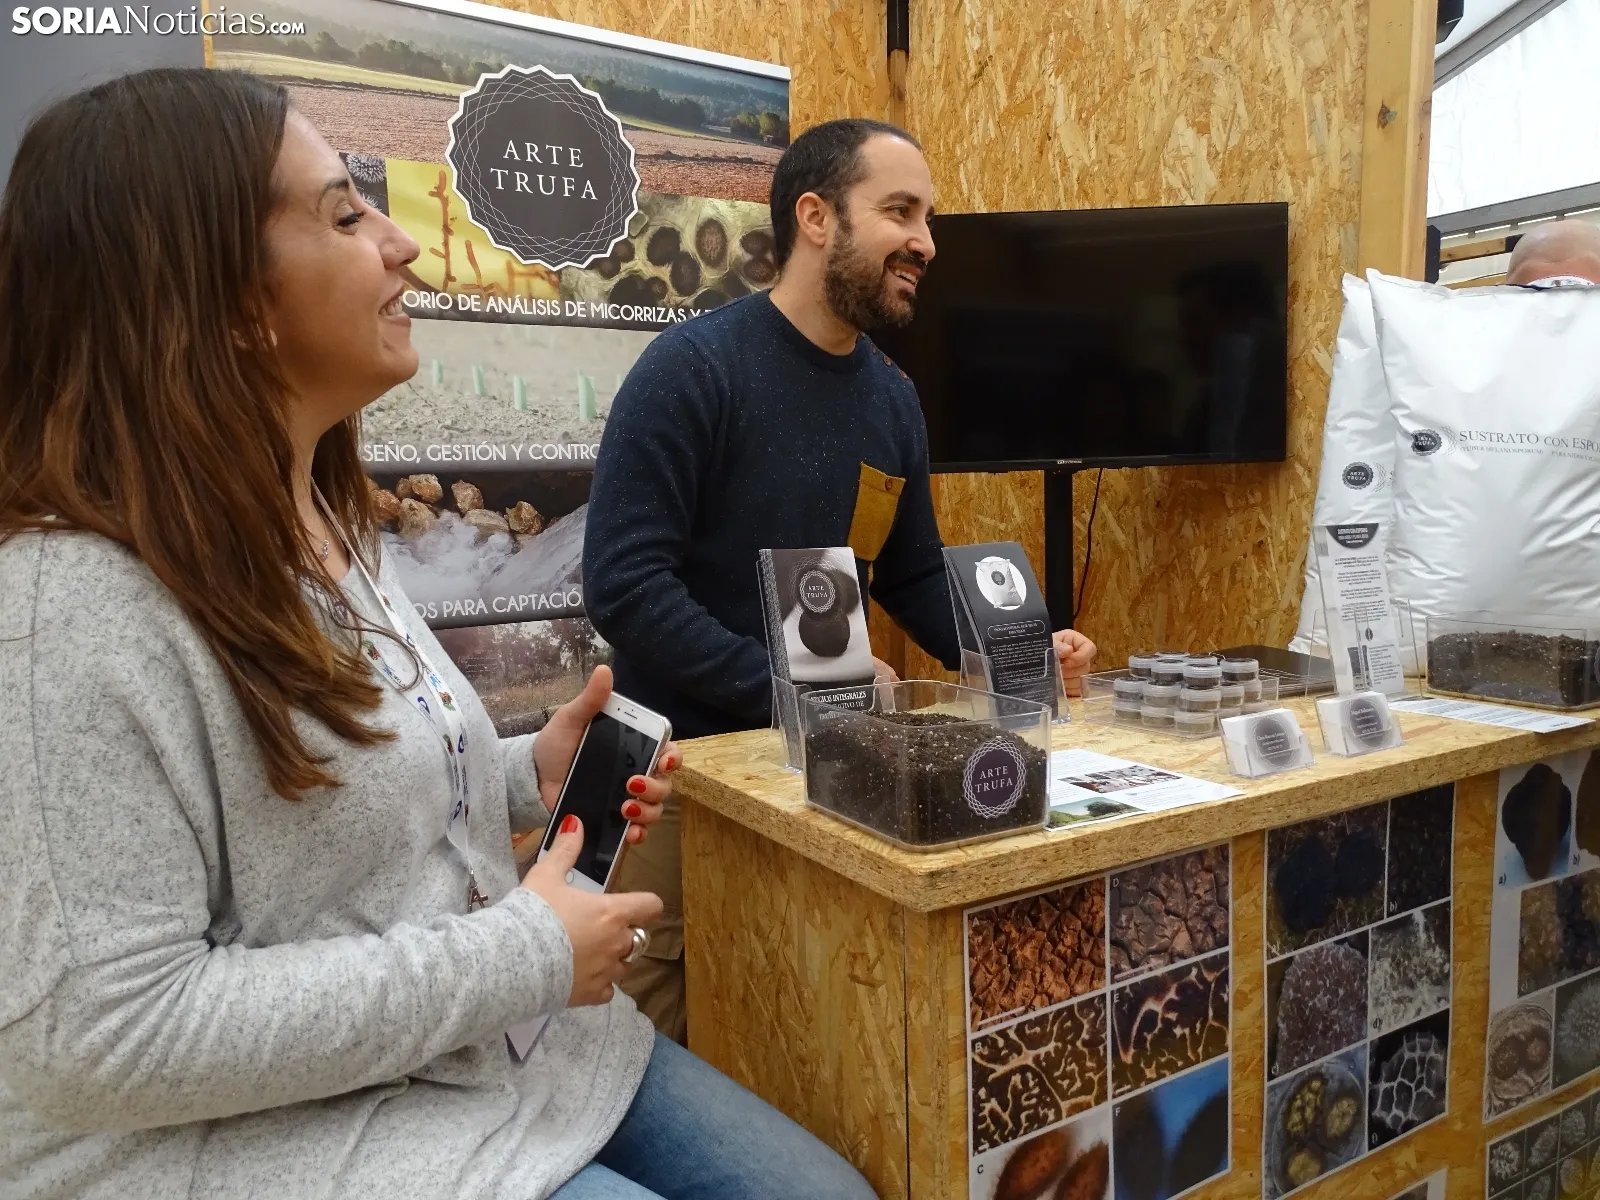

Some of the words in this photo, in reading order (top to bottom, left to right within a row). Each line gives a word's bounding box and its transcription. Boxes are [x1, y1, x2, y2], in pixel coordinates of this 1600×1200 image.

[502, 139, 584, 168] ARTE
[489, 167, 599, 200] TRUFA
[457, 293, 481, 312] DE
[485, 295, 561, 316] ANÁLISIS
[565, 300, 586, 318] DE
[590, 302, 687, 323] MICORRIZAS
[426, 440, 507, 461] GESTIÓN
[510, 443, 524, 461] Y
[1459, 430, 1540, 444] SUSTRATO
[1543, 436, 1569, 448] CON
[1572, 437, 1600, 453] ESPO
[442, 597, 489, 618] PARA
[492, 587, 584, 613] CAPTACIÓ
[979, 765, 1009, 780] ARTE
[974, 777, 1013, 793] TRUFA
[972, 916, 980, 928] A
[1113, 992, 1120, 1004] E
[1115, 1106, 1121, 1117] F
[977, 1164, 984, 1175] C
